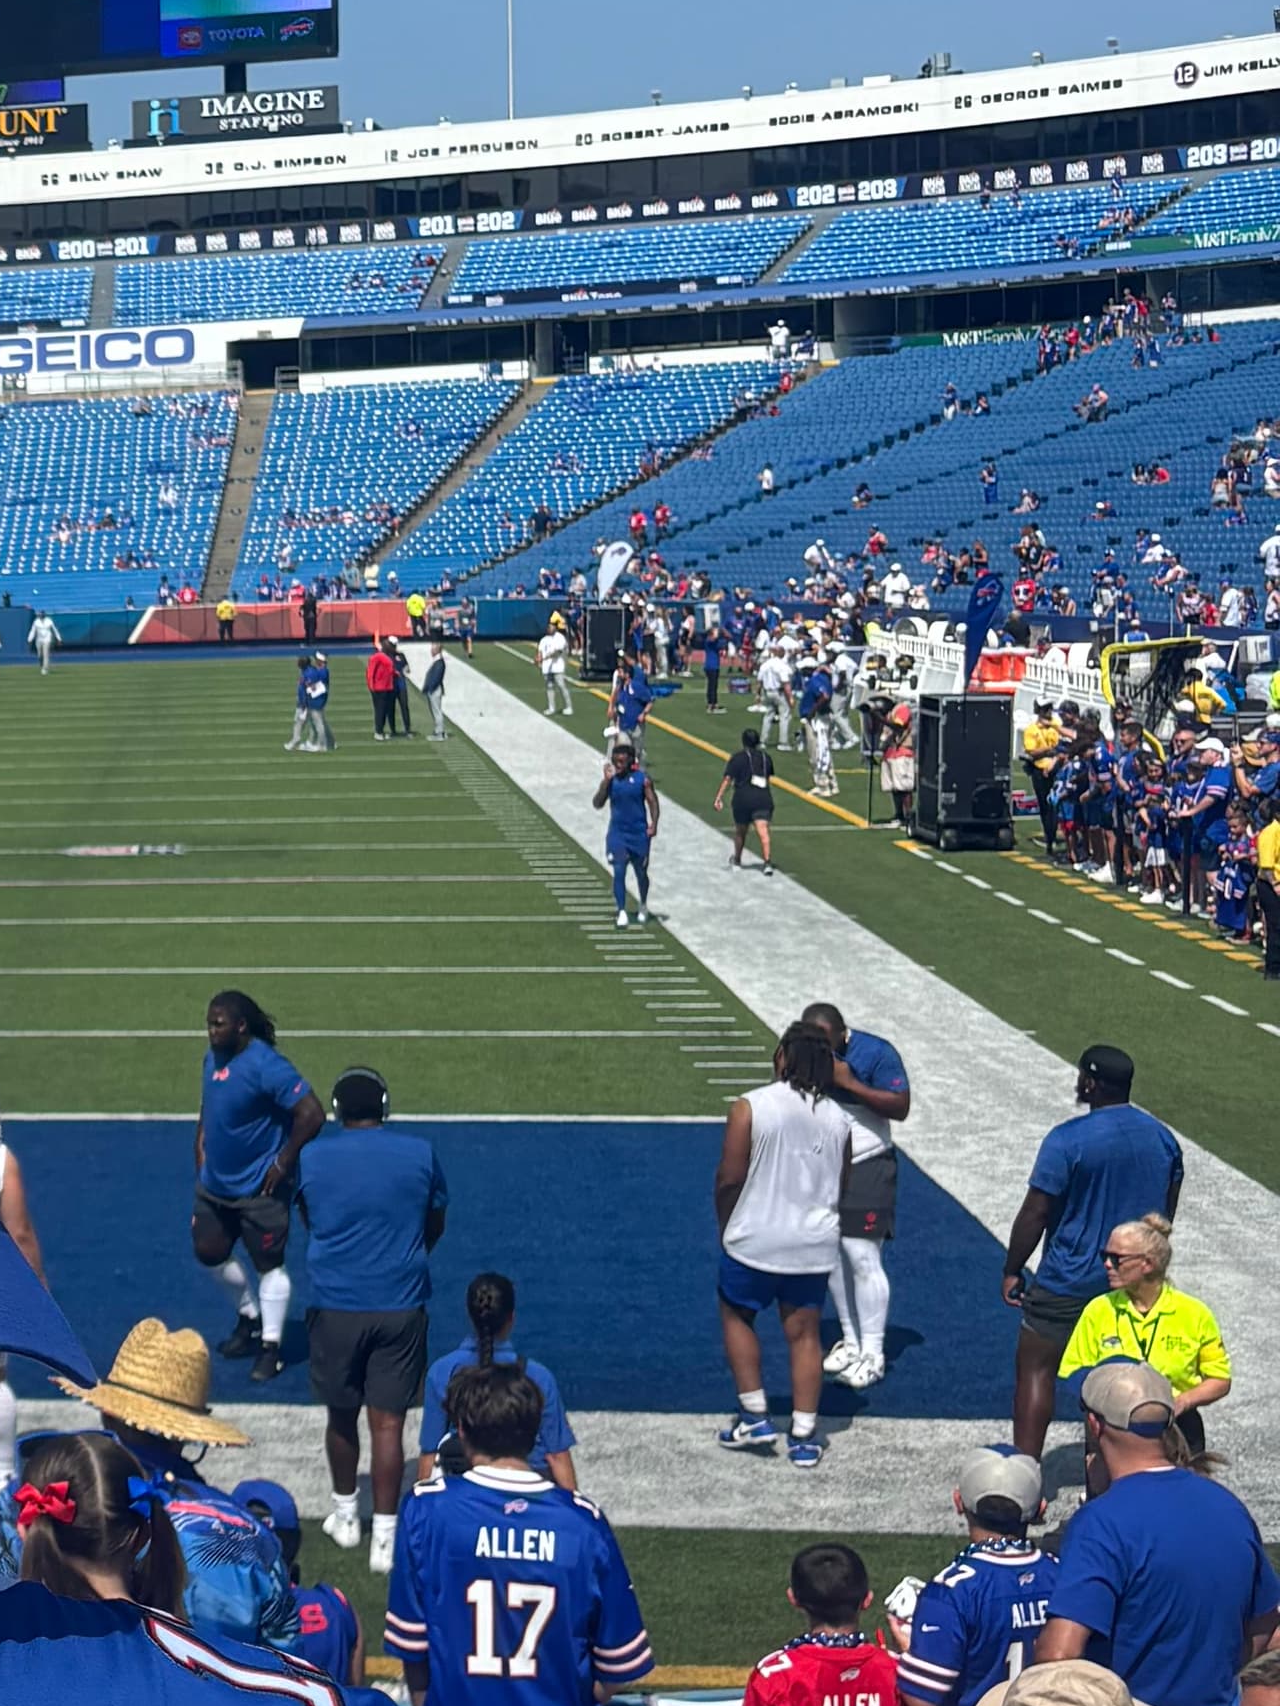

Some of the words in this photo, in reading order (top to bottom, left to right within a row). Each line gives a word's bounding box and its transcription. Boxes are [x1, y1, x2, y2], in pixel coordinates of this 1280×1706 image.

[208, 25, 264, 41] TOYOTA
[1175, 66, 1195, 85] 12
[1203, 65, 1233, 78] JIM
[1238, 58, 1280, 72] KELLY
[200, 90, 325, 118] IMAGINE
[219, 113, 304, 131] STAFFING
[407, 148, 440, 159] JOE
[1187, 145, 1228, 169] 203
[1250, 138, 1280, 161] 20
[69, 170, 110, 183] BILLY
[796, 186, 836, 207] 202
[419, 216, 455, 236] 201
[476, 211, 515, 232] 202
[57, 240, 96, 260] 200
[114, 236, 150, 256] 201
[475, 1526, 555, 1562] ALLEN
[1011, 1600, 1049, 1630] ALLE
[466, 1580, 558, 1678] 17
[1005, 1641, 1024, 1680] 1
